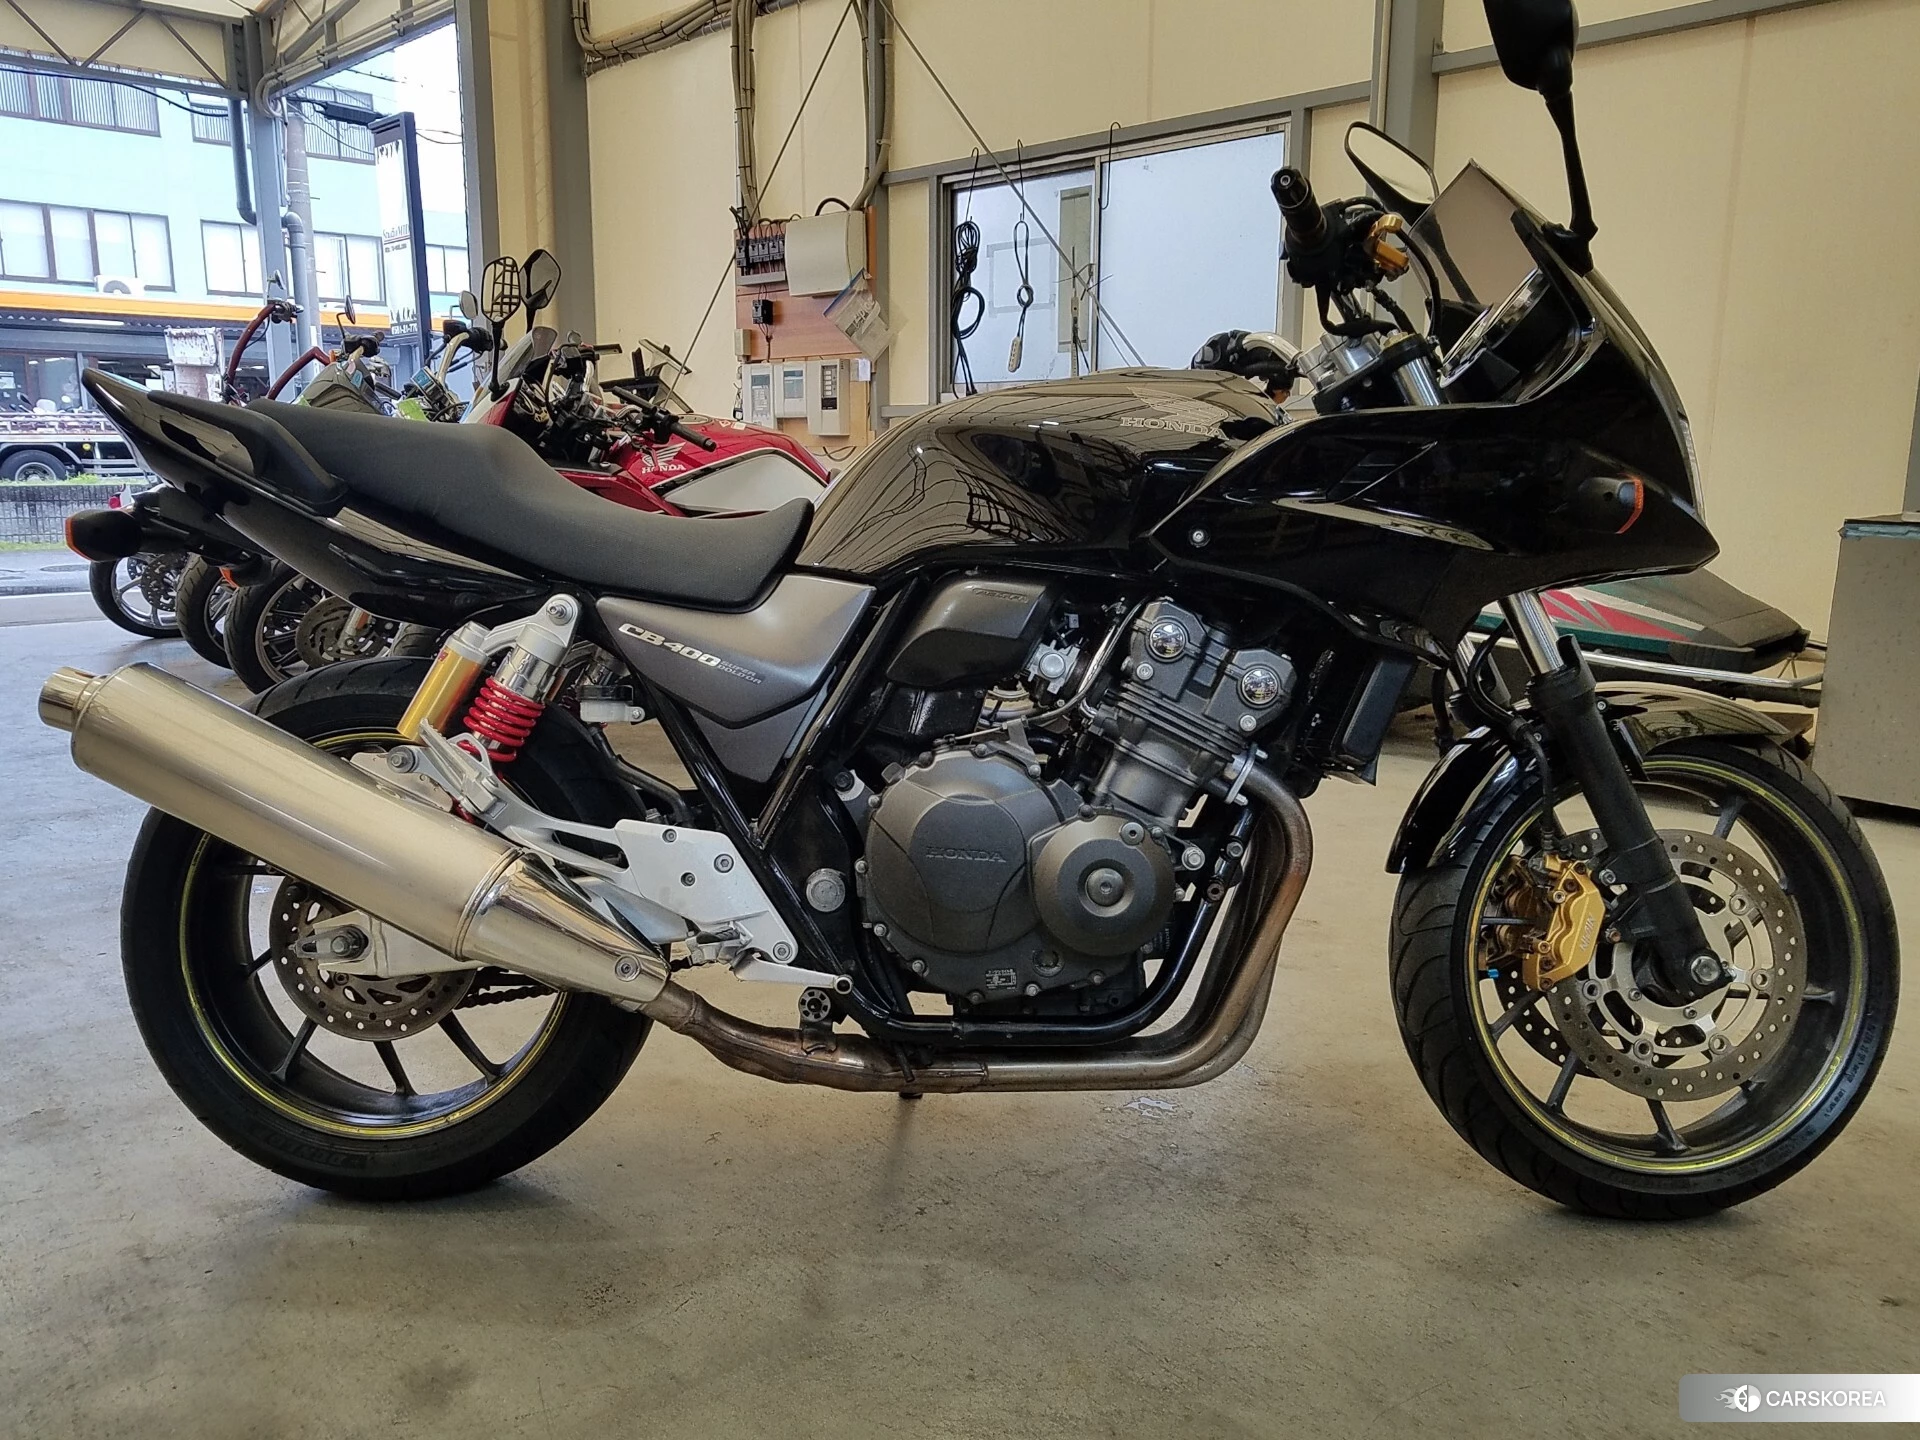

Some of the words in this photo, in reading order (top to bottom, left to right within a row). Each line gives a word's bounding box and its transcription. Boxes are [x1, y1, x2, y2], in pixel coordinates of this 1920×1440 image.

[1120, 416, 1230, 441] HONDA
[618, 623, 722, 667] CB400
[926, 846, 1007, 863] HONDA
